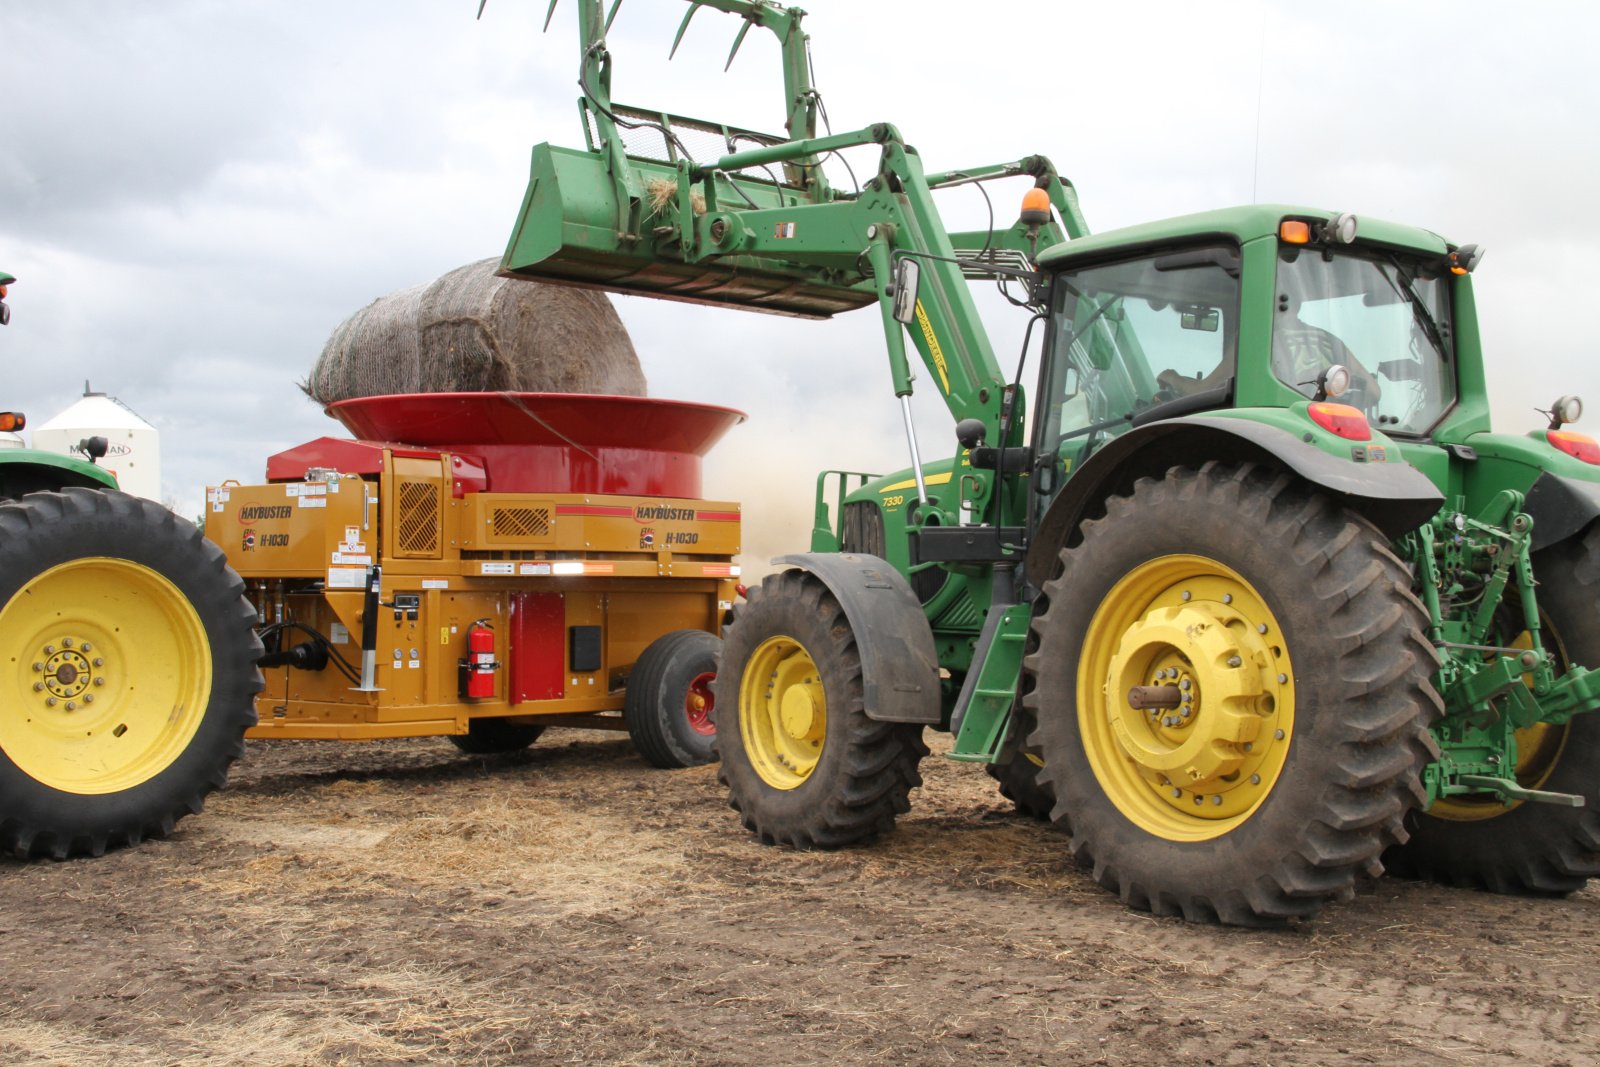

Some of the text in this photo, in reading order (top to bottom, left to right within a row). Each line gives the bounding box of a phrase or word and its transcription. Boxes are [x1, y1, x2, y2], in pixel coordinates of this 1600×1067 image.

[883, 495, 904, 507] 7330
[241, 505, 292, 519] HAYBUSTER
[636, 506, 695, 520] HAYBUSTER
[260, 534, 289, 546] H-1030
[665, 532, 699, 544] H-1030
